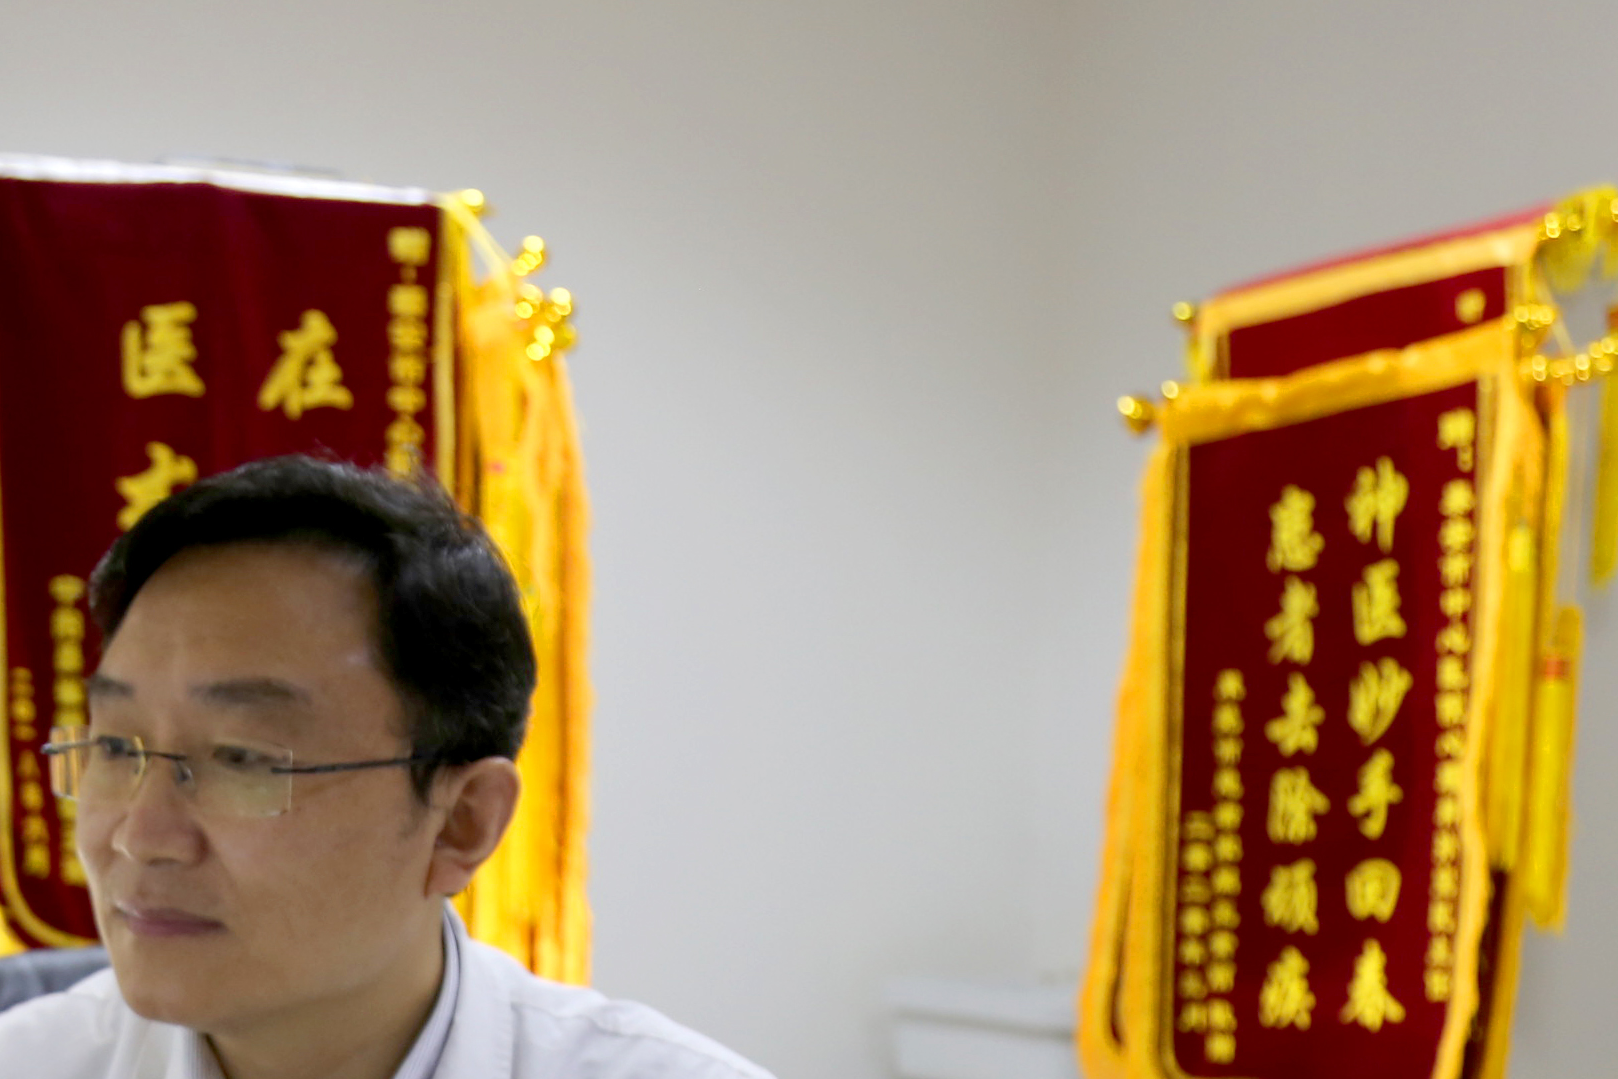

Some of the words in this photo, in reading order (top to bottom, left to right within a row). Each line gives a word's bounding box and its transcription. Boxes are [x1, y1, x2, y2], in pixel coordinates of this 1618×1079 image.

[257, 308, 354, 421] 在
[1339, 455, 1414, 1034] 神医妙手回春
